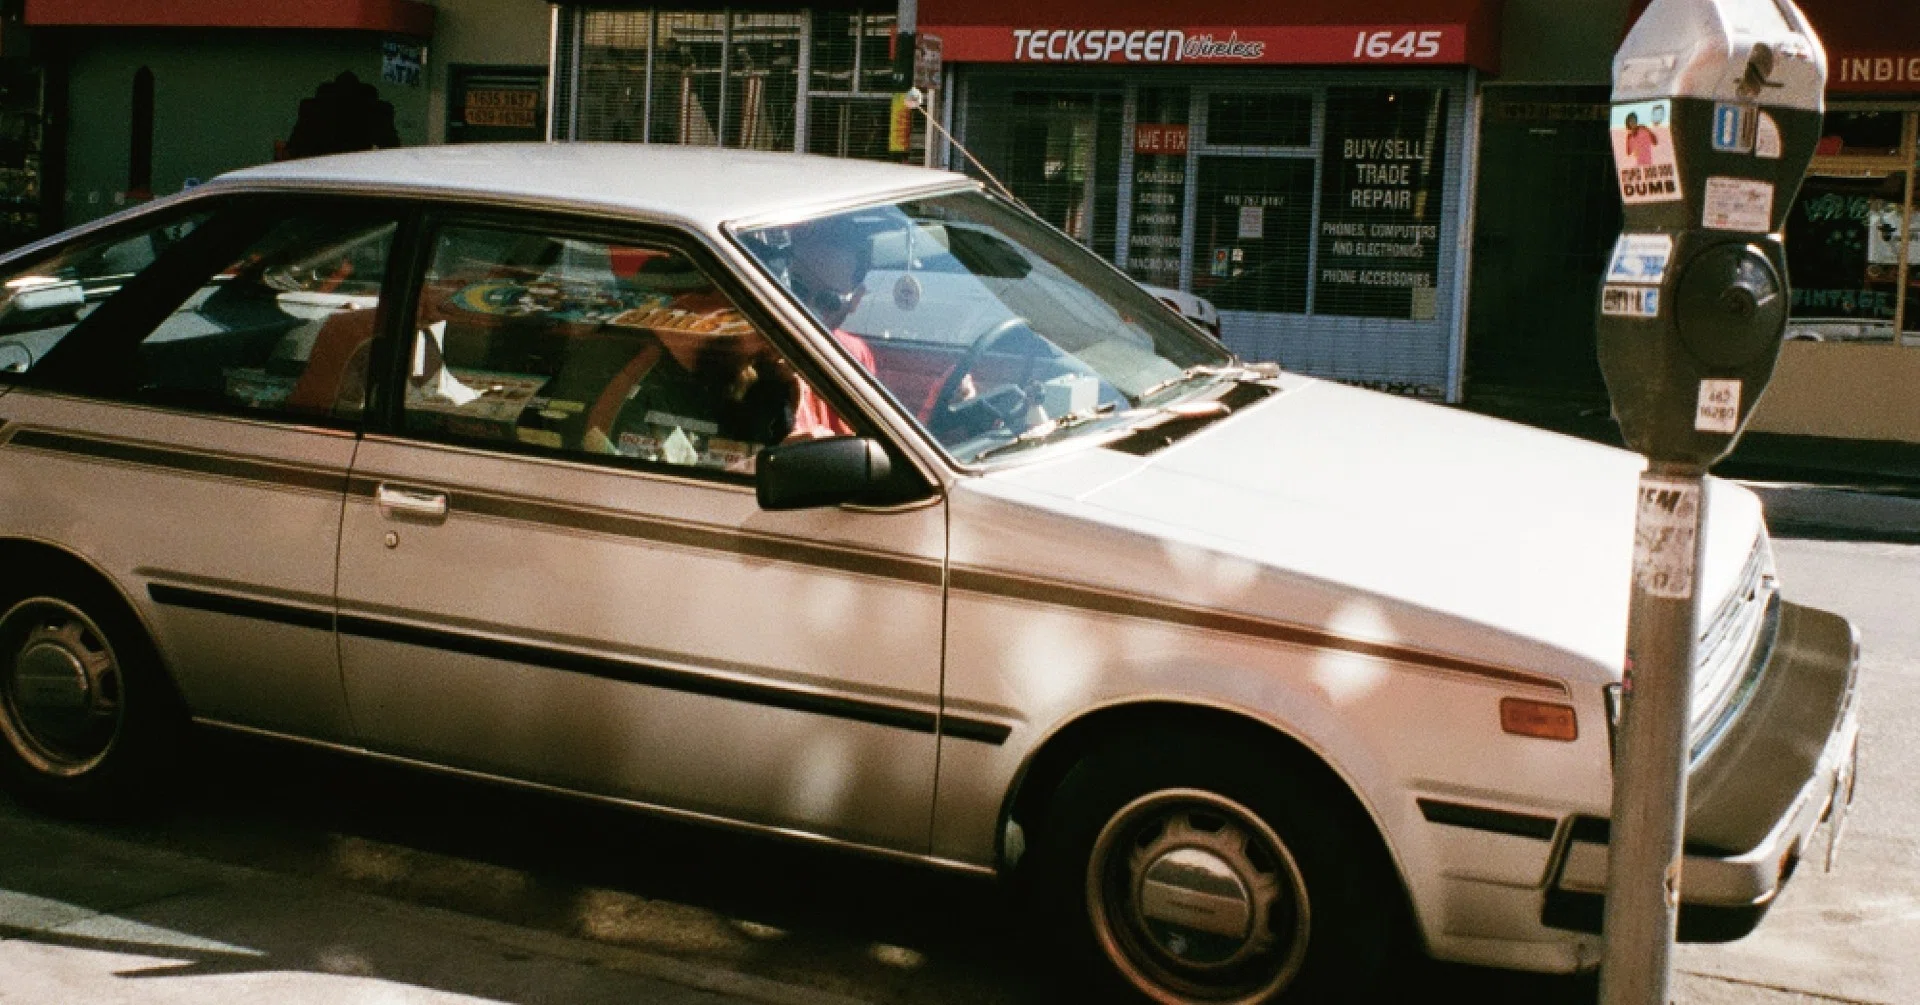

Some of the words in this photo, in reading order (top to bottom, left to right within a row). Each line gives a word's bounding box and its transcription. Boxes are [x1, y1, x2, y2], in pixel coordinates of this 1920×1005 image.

[1013, 29, 1184, 61] TECKSPEEN
[1184, 30, 1265, 58] Wireless
[1353, 31, 1442, 58] 1645
[1138, 130, 1160, 149] WE
[1163, 130, 1186, 150] FIX
[1343, 139, 1424, 159] BUY/SELL
[1355, 163, 1410, 184] TRADE
[1623, 179, 1676, 197] DUMB
[1351, 188, 1411, 209] REPAIR
[1371, 223, 1436, 239] COMPUTERS
[1332, 240, 1353, 256] AND
[1355, 242, 1424, 258] ELECTRONICS
[1322, 269, 1357, 284] PHONE
[1359, 271, 1430, 287] ACCESSORIES
